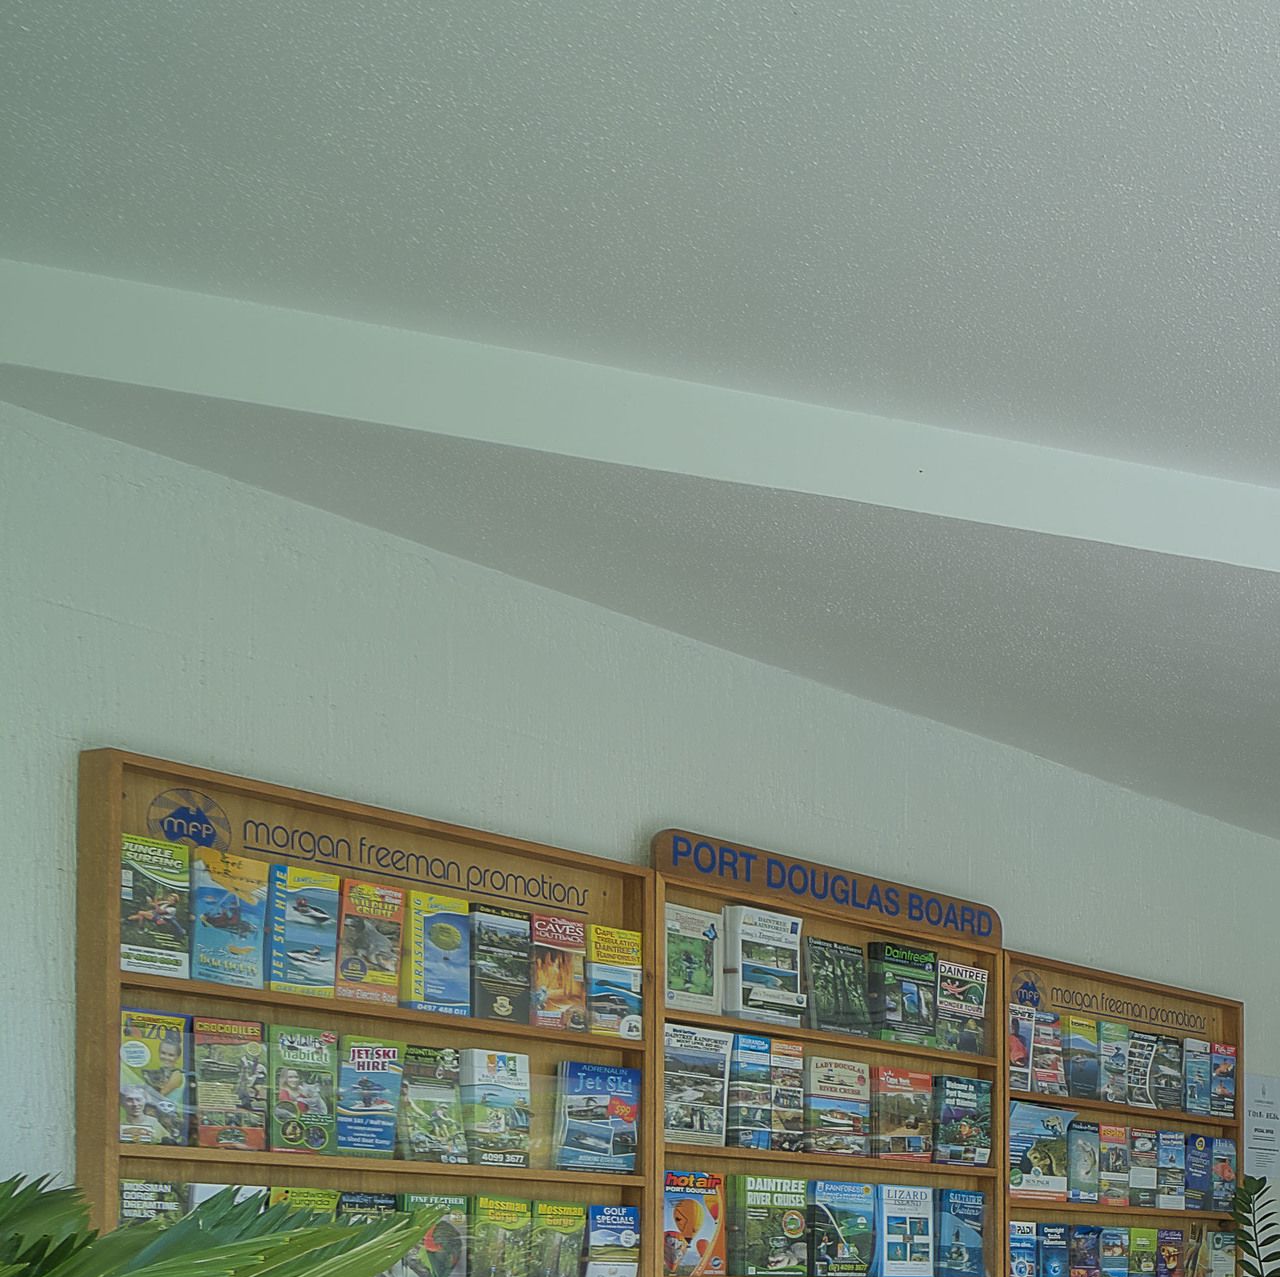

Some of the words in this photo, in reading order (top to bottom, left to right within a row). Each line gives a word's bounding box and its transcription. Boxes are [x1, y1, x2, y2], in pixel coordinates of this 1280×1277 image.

[123, 842, 174, 860] JUNGLE
[125, 854, 184, 873] SURFING
[244, 820, 352, 863] morgan
[360, 837, 461, 883] freeman
[466, 866, 589, 907] promotions
[279, 870, 289, 910] HIRE
[672, 836, 758, 882] PORT
[767, 859, 901, 917] DOUGLAS
[908, 893, 994, 938] BOARD
[275, 915, 286, 946] SKI
[535, 920, 585, 938] CAVES
[413, 897, 424, 997] PARASAILING
[884, 945, 927, 964] Daintree
[272, 950, 284, 980] JET
[938, 962, 988, 984] DAINTREE
[1051, 986, 1099, 1010] morgan
[1101, 993, 1148, 1018] freeman
[196, 1020, 262, 1037] CROCODILES
[351, 1047, 374, 1063] JET
[375, 1048, 398, 1063] SKI
[356, 1060, 389, 1072] HIRE
[815, 1061, 833, 1070] LADY
[575, 1074, 602, 1093] Jet
[606, 1076, 634, 1094] Ski
[666, 1171, 695, 1187] hot
[696, 1174, 721, 1189] air
[746, 1176, 805, 1194] DAINTREE
[665, 1185, 684, 1194] PORT
[685, 1187, 717, 1196] DOUGLAS
[746, 1190, 772, 1207] RIVER
[773, 1192, 805, 1208] CRUISES
[887, 1188, 929, 1201] LIZARD
[479, 1195, 528, 1213] Mossman
[538, 1202, 584, 1217] Mossman
[603, 1206, 629, 1217] GOLF
[488, 1208, 521, 1223] Gorge
[547, 1216, 578, 1229] Gorge
[595, 1215, 636, 1227] SPECIALS
[1016, 1225, 1034, 1235] PADI
